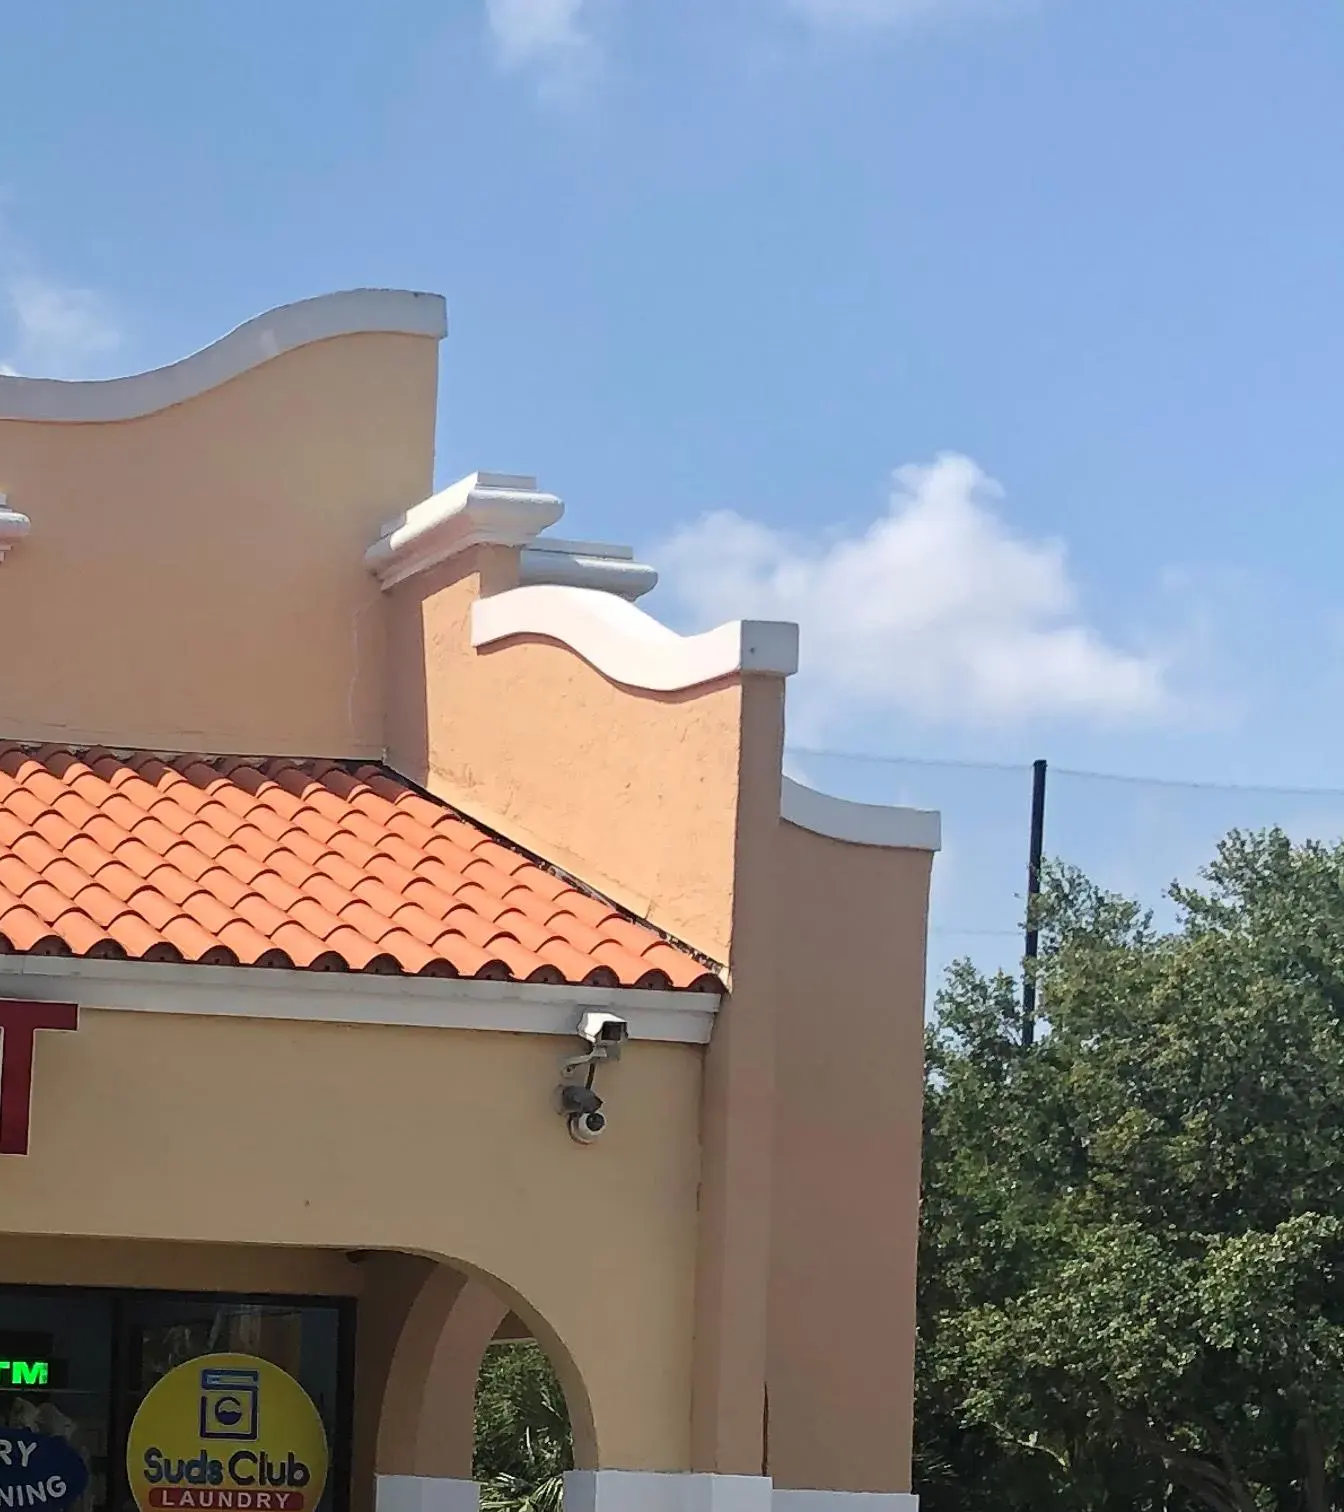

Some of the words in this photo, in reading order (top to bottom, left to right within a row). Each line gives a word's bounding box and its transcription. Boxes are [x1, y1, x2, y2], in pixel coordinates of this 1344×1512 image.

[143, 1447, 224, 1485] Suds
[228, 1450, 311, 1487] Club
[162, 1490, 291, 1509] LAUNDRY
